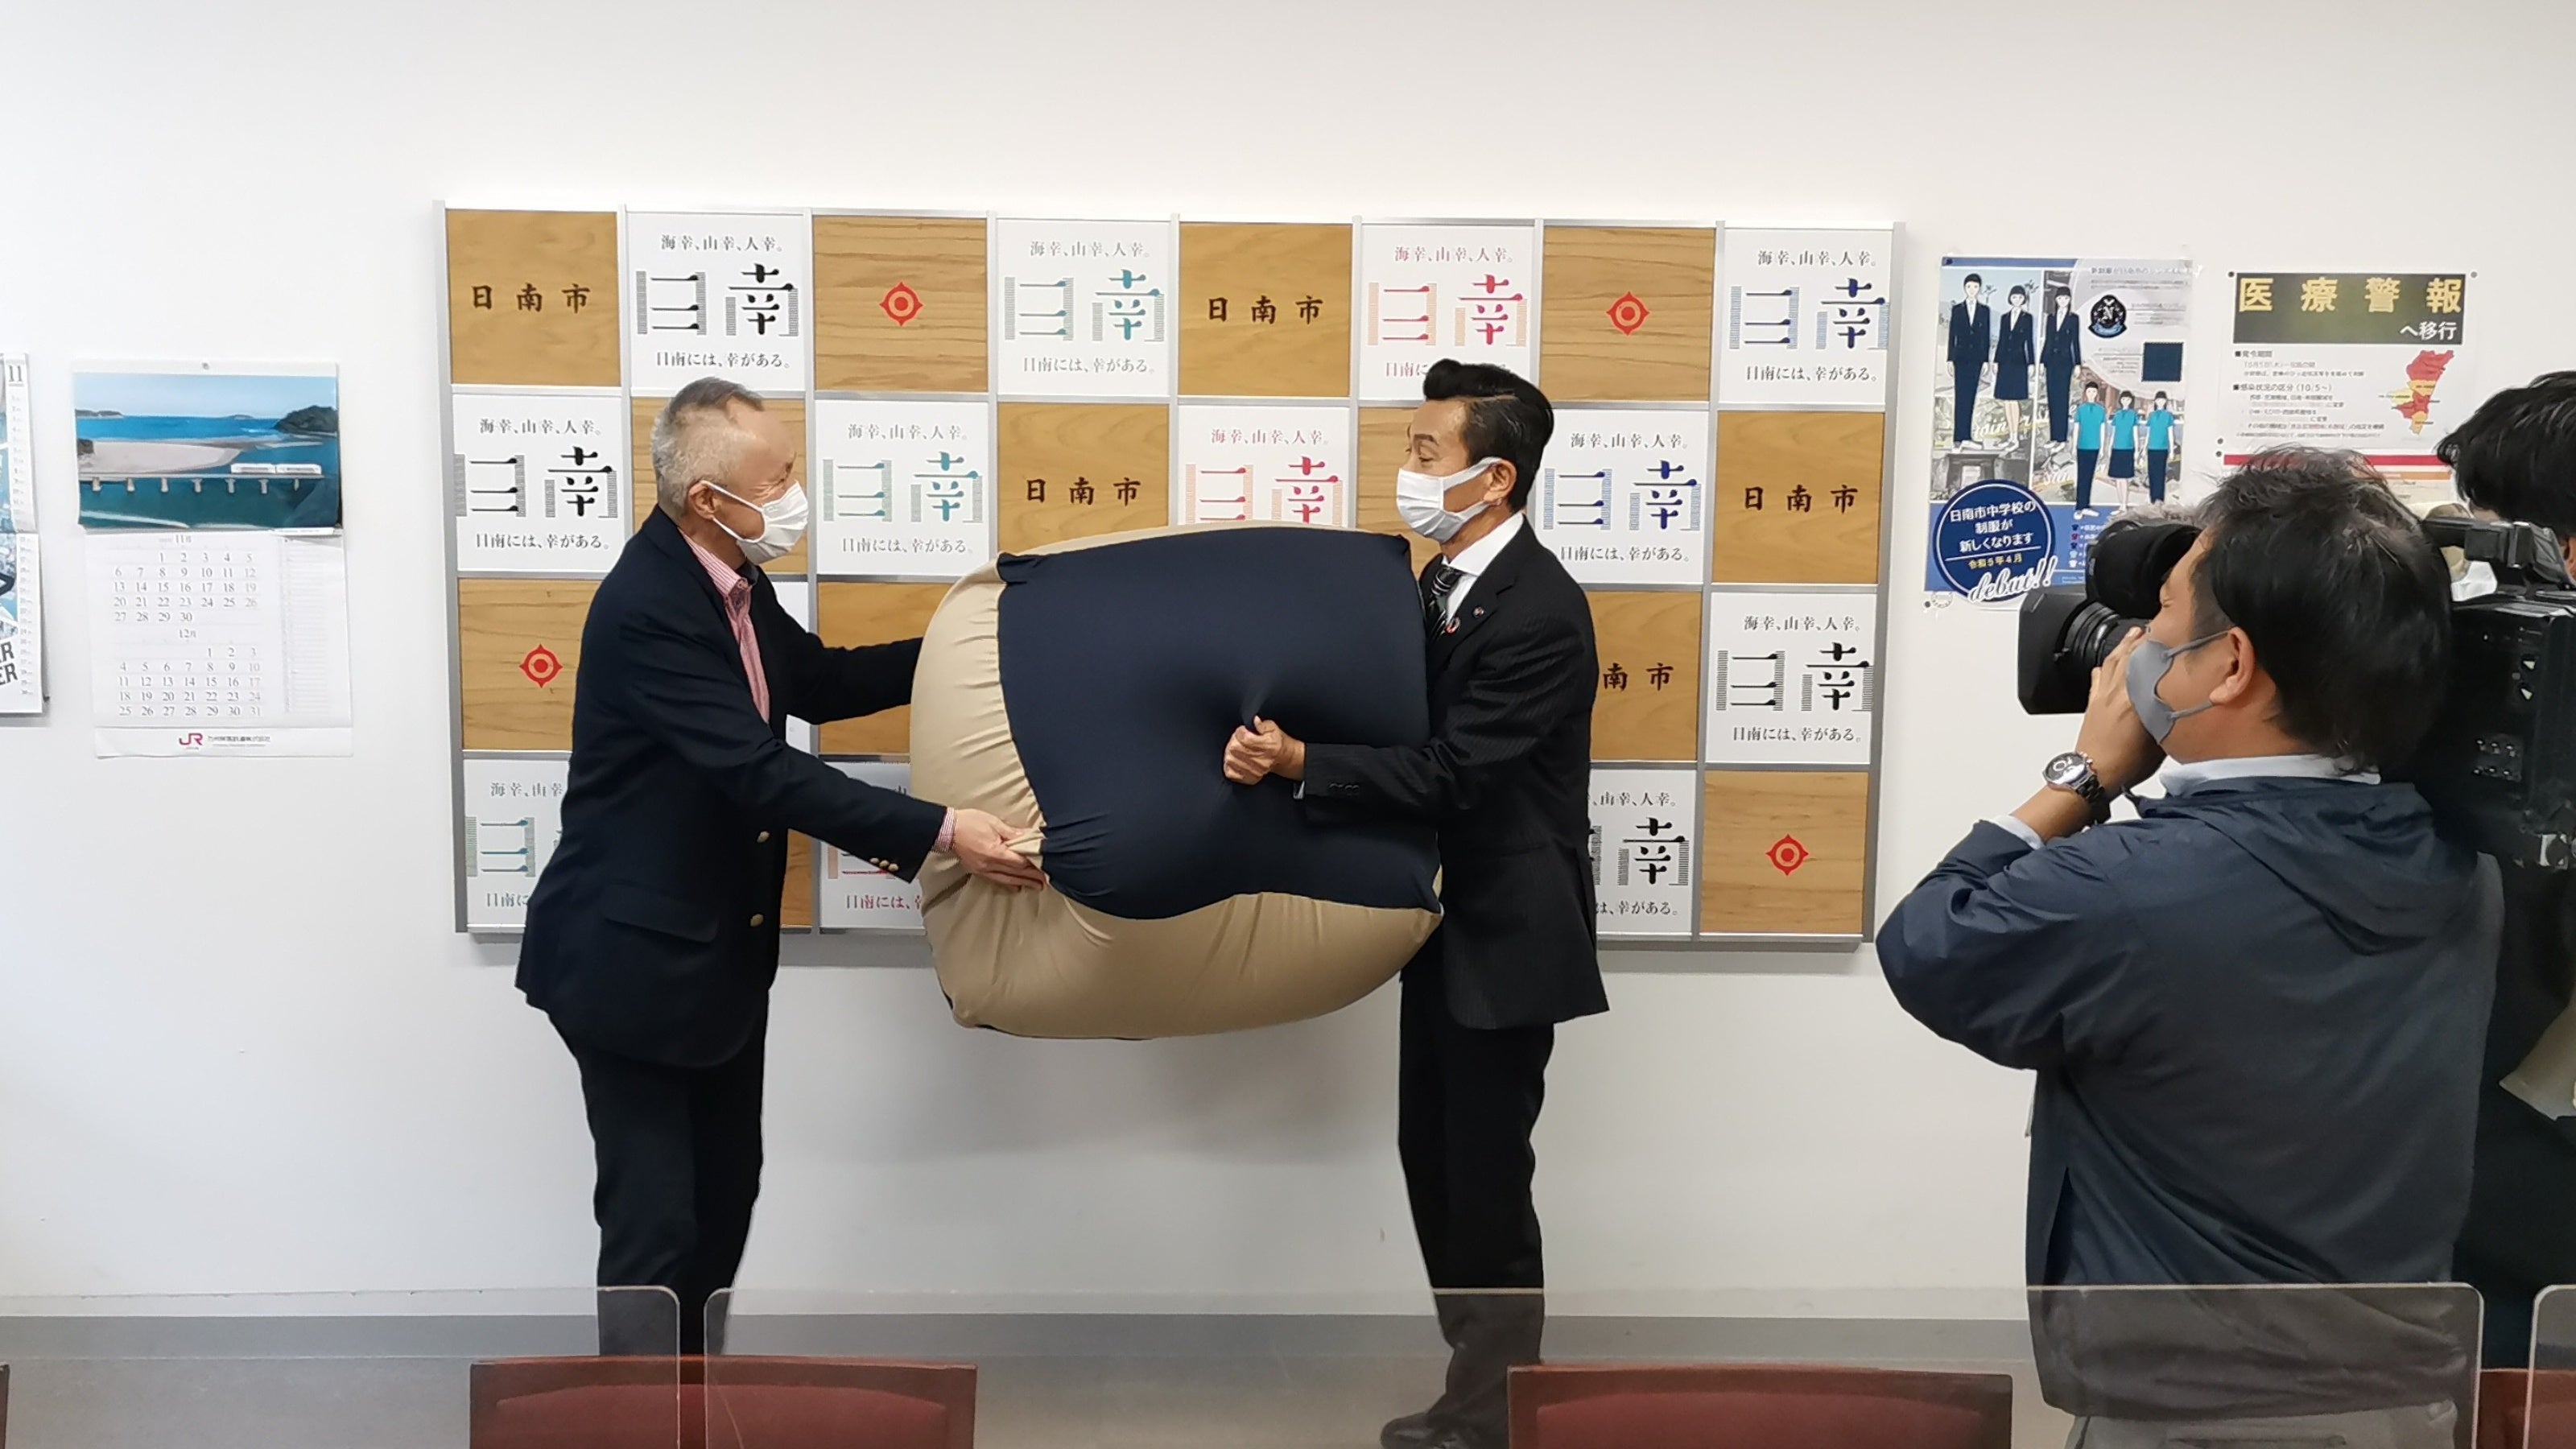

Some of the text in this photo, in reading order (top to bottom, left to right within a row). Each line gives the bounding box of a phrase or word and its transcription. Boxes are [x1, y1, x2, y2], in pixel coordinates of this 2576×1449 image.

[472, 283, 590, 314] 日南市
[2239, 277, 2462, 313] 医療警報
[1208, 295, 1323, 324] 日南市
[2400, 321, 2456, 341] へ移行
[1027, 477, 1140, 506] 日南市
[1744, 485, 1858, 514] 日南市
[1950, 501, 2036, 522] 日南市中学校の
[1975, 519, 2013, 534] 制服が
[1959, 532, 2033, 552] 新しくなります
[1967, 555, 2058, 602] debut!!
[0, 642, 14, 663] R
[1603, 663, 1674, 691] 南市
[179, 733, 203, 745] JR
